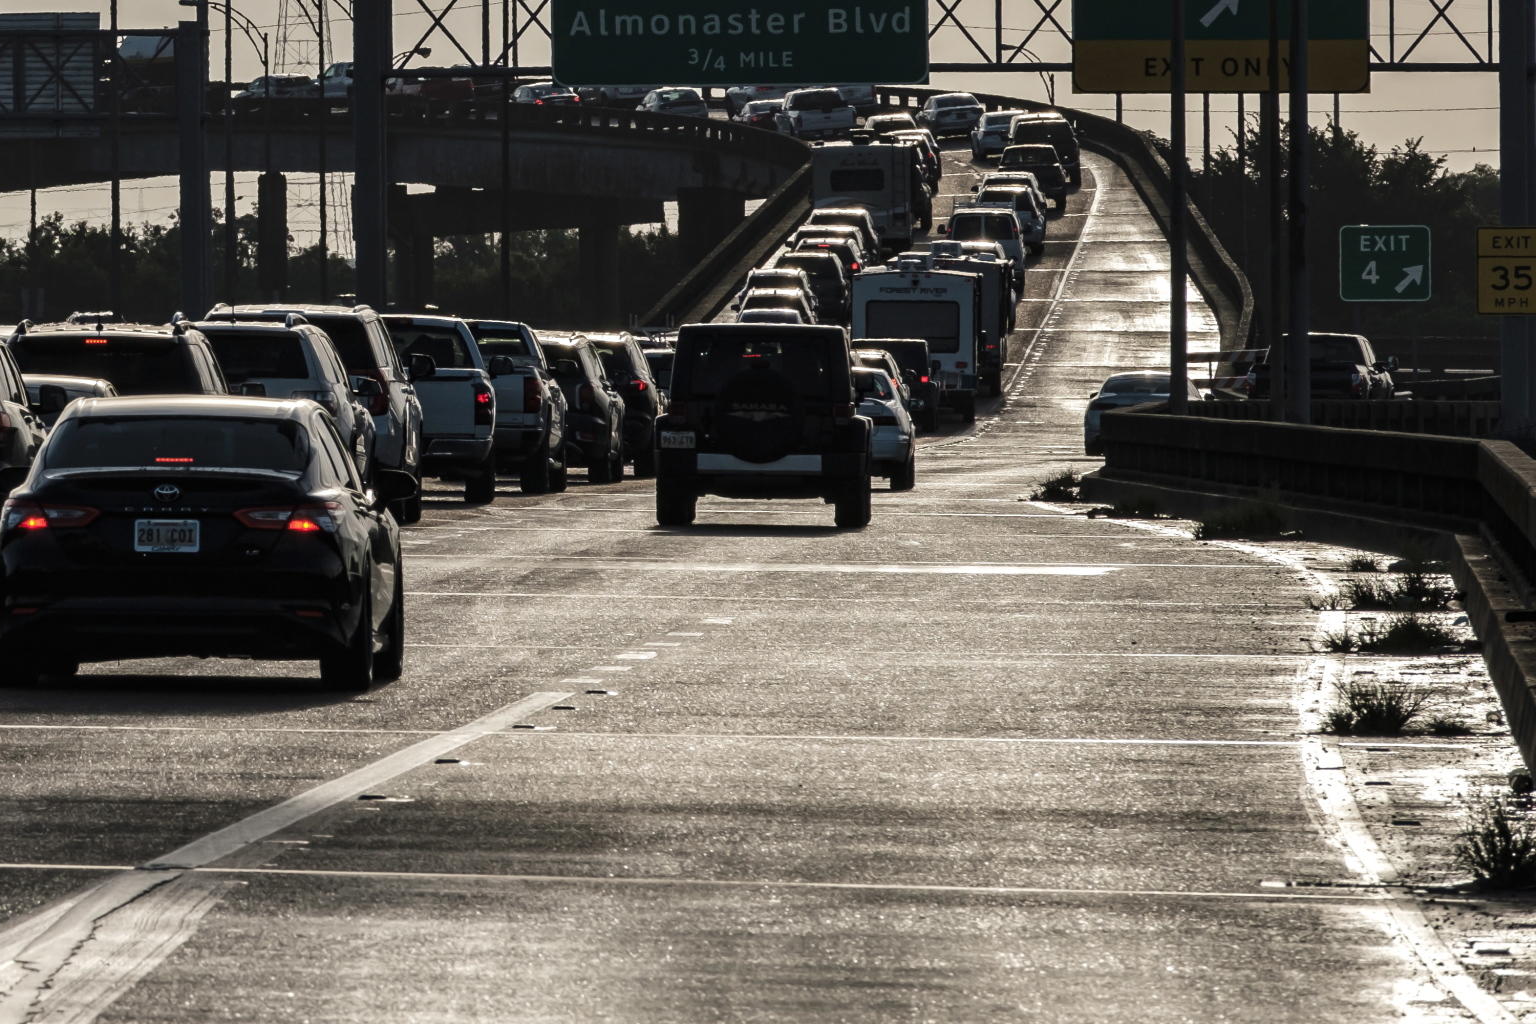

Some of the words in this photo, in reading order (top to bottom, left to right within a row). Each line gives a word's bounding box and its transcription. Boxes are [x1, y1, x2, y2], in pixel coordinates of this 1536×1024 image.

[569, 8, 806, 36] Almonaster
[827, 6, 911, 34] Blvd
[687, 48, 726, 72] 3/4
[740, 51, 794, 68] MILE
[1144, 58, 1204, 77] EXT
[1360, 235, 1410, 252] EXIT
[1492, 236, 1531, 249] EXIT
[1361, 260, 1380, 284] 4
[1490, 266, 1533, 291] 35
[1494, 298, 1529, 308] MPH
[138, 528, 161, 543] 281
